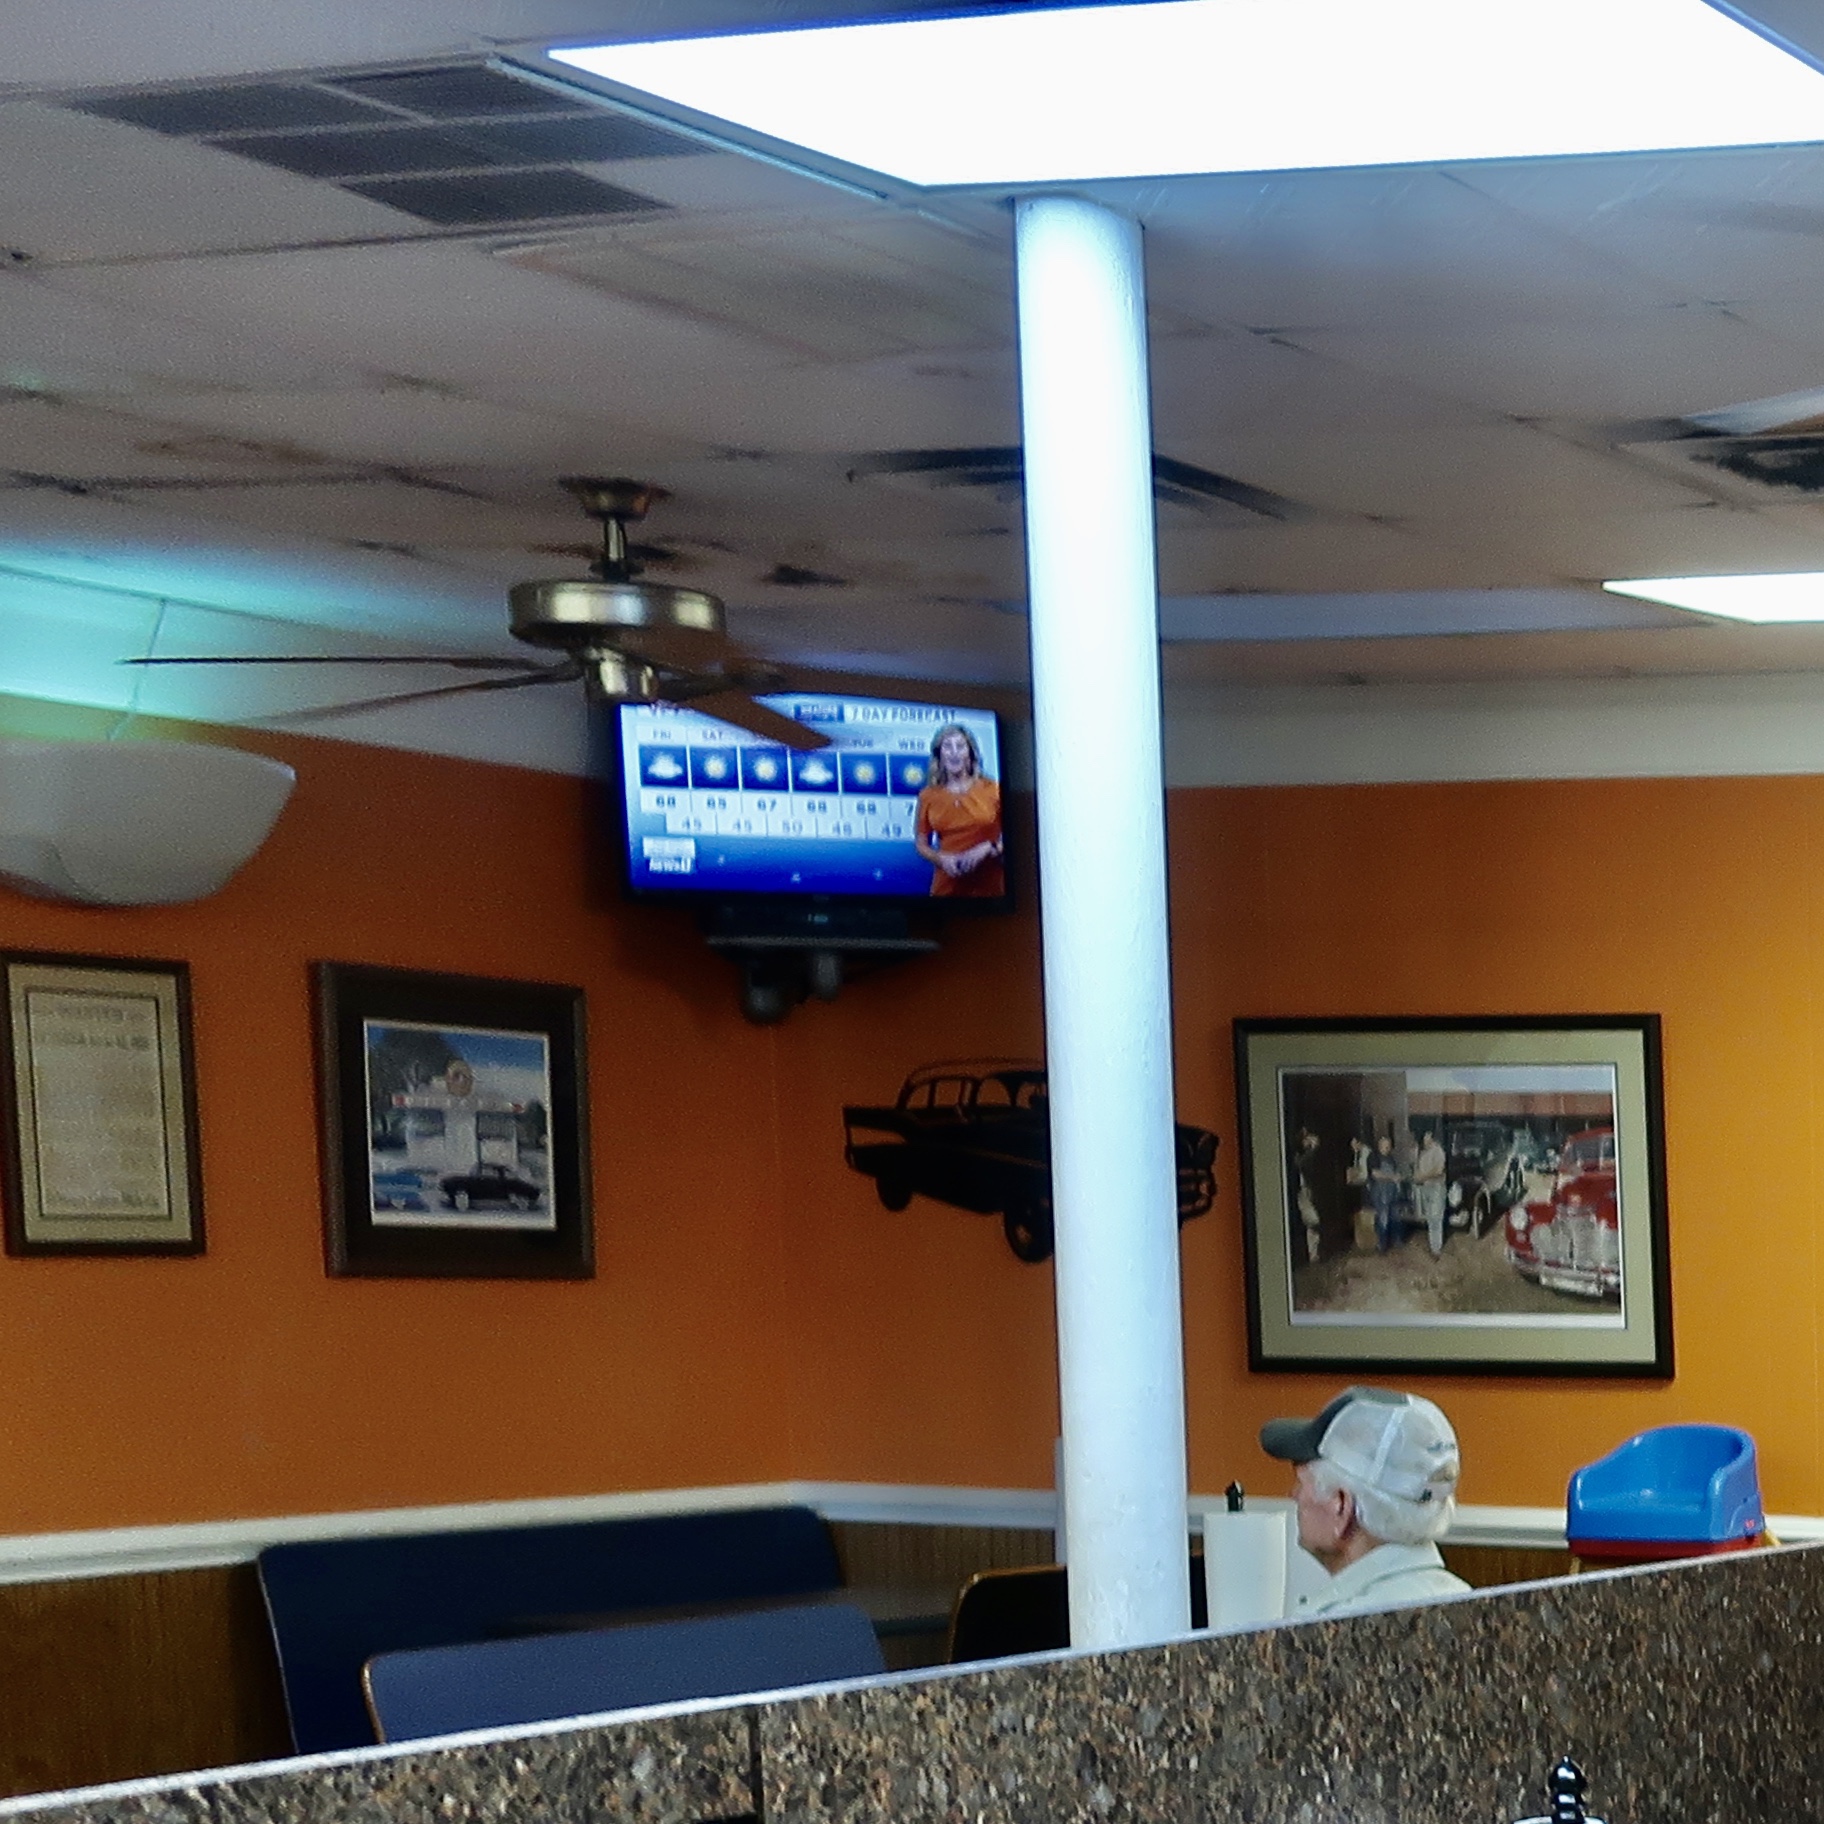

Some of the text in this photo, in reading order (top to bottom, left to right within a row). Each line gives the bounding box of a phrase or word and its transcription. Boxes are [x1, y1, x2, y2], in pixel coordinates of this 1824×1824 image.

[862, 708, 888, 721] DAY
[892, 709, 955, 723] FORECAST
[757, 799, 777, 811] 67
